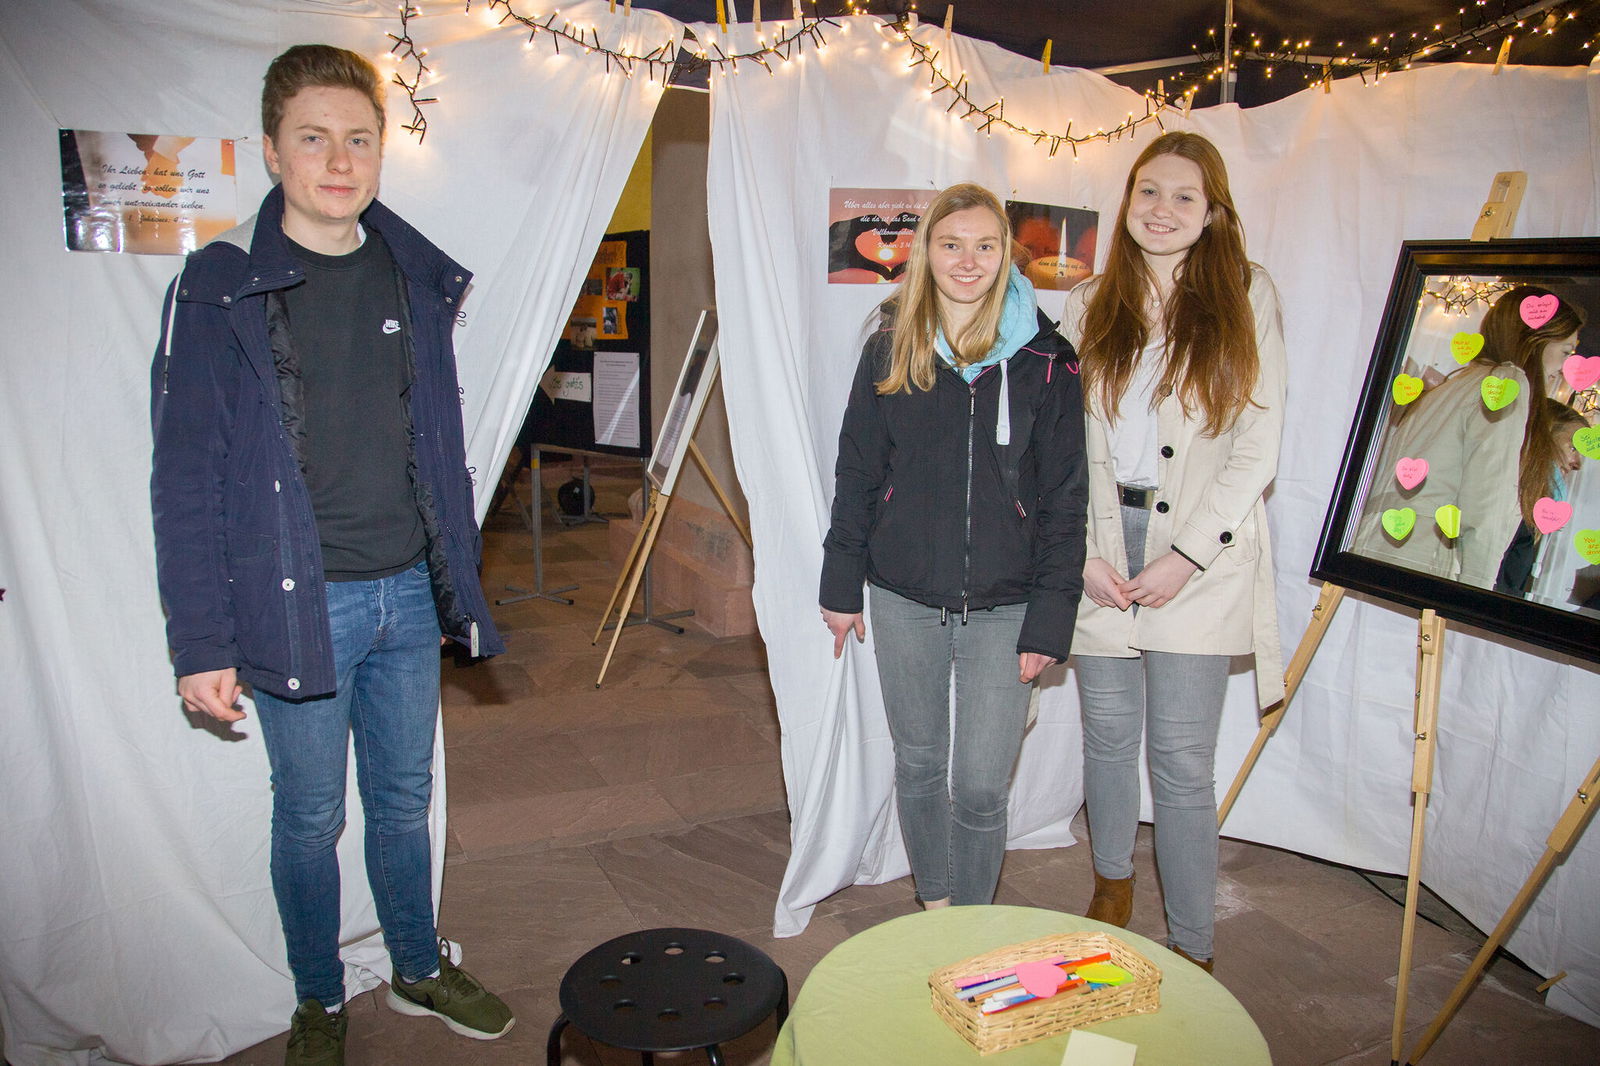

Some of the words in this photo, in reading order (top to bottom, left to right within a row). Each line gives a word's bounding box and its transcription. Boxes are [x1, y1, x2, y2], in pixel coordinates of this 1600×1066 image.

[154, 167, 167, 176] hat
[188, 169, 206, 181] Gott
[155, 184, 177, 193] sollen
